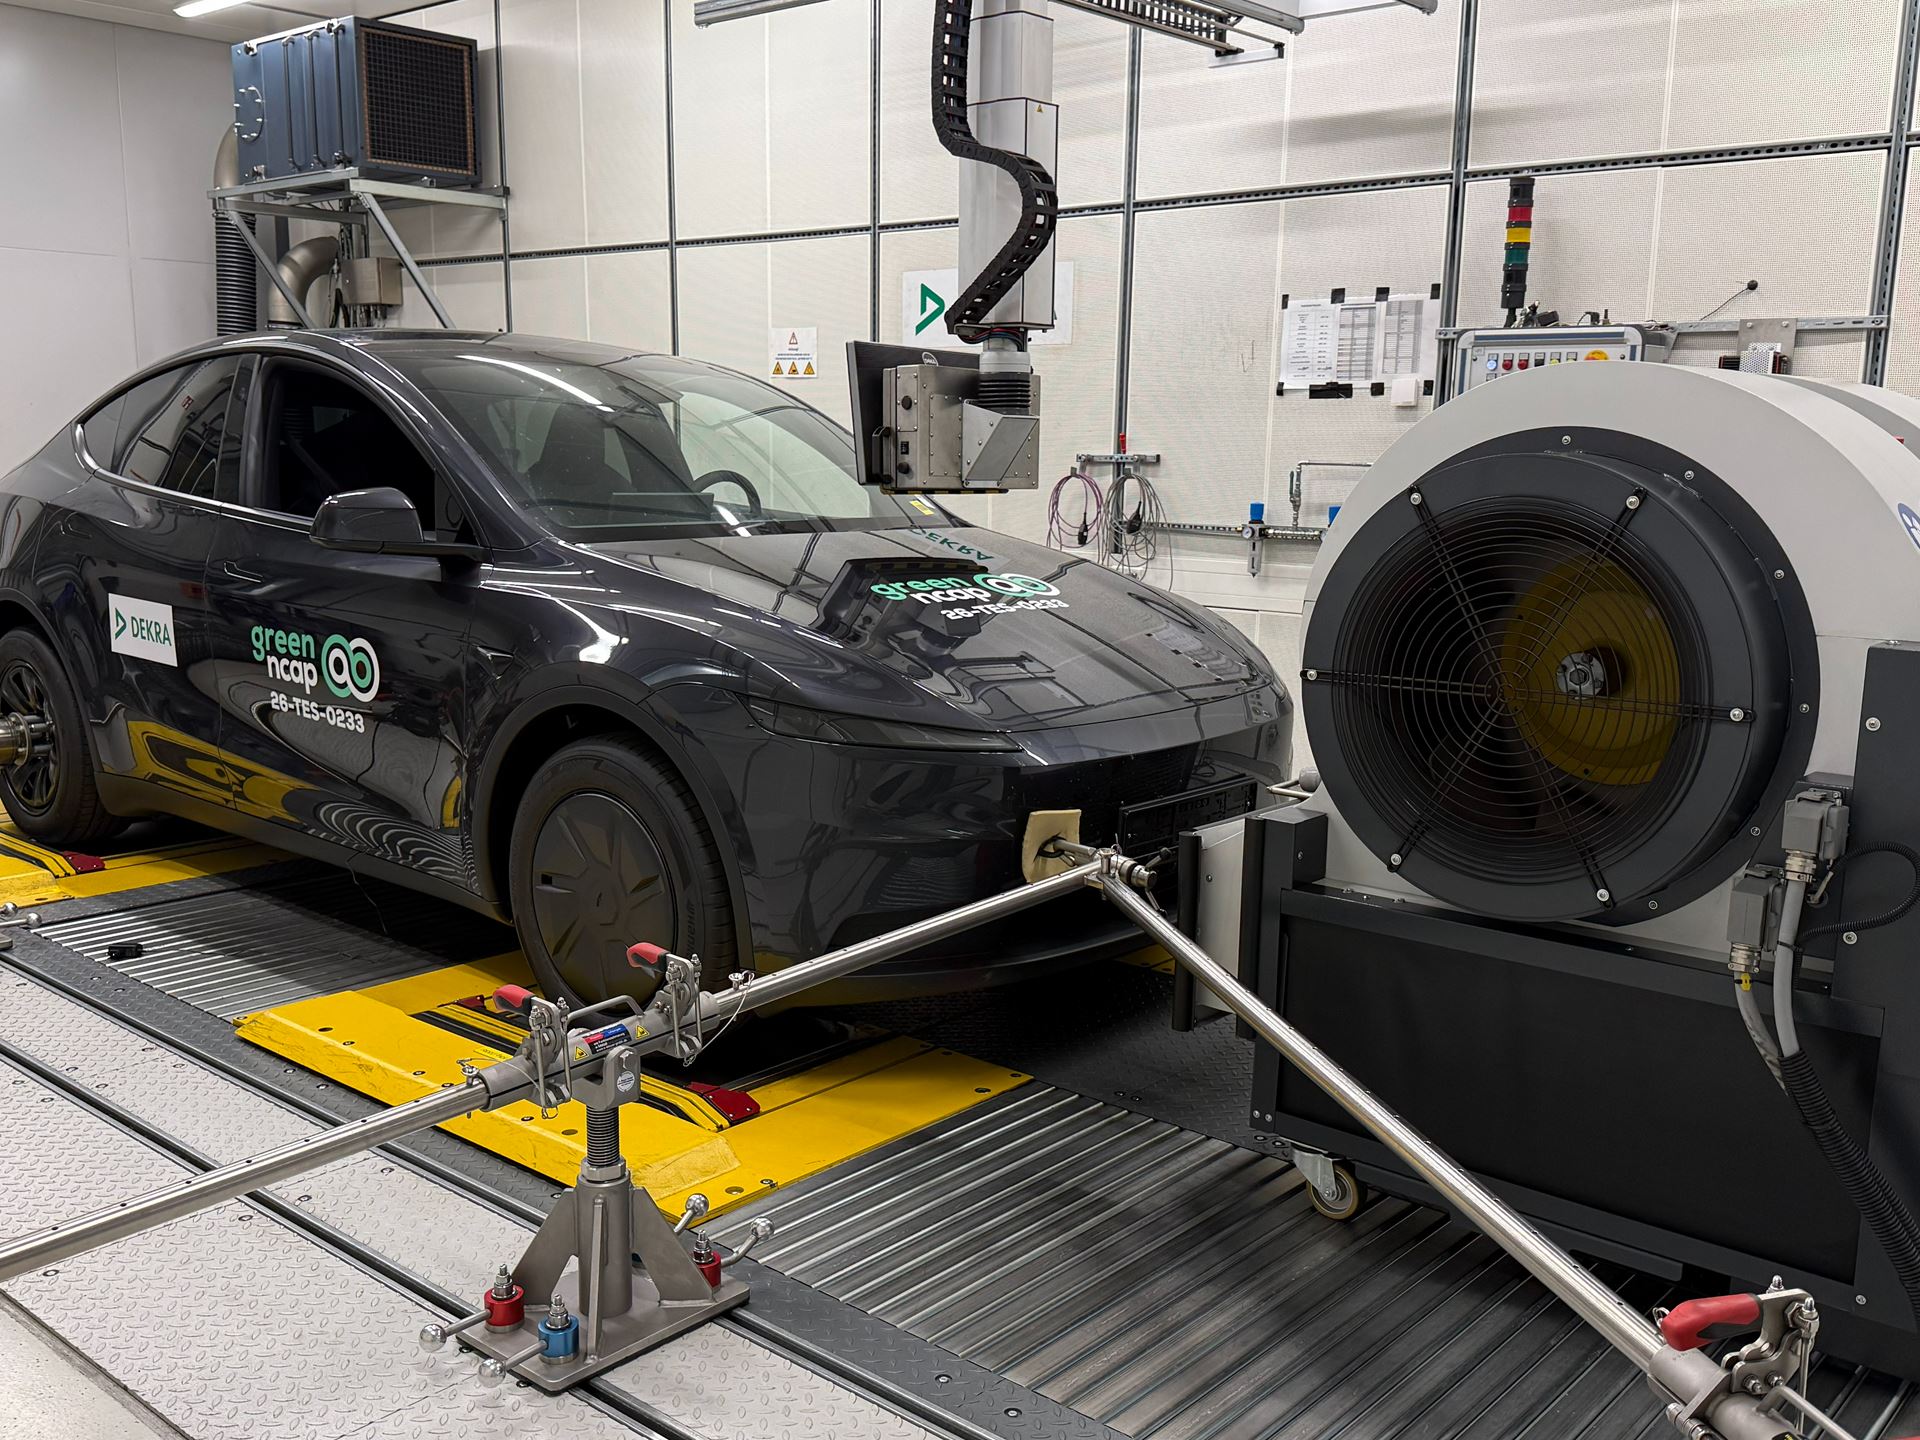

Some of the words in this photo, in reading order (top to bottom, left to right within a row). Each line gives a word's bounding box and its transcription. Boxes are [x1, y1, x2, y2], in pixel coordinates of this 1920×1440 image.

[870, 577, 973, 601] green
[909, 587, 993, 605] ncap
[940, 598, 1070, 620] 26-TES-0233
[131, 615, 172, 647] DEKRA
[251, 625, 316, 662] green
[266, 655, 318, 695] ncap
[270, 691, 365, 733] 26-TES-0233
